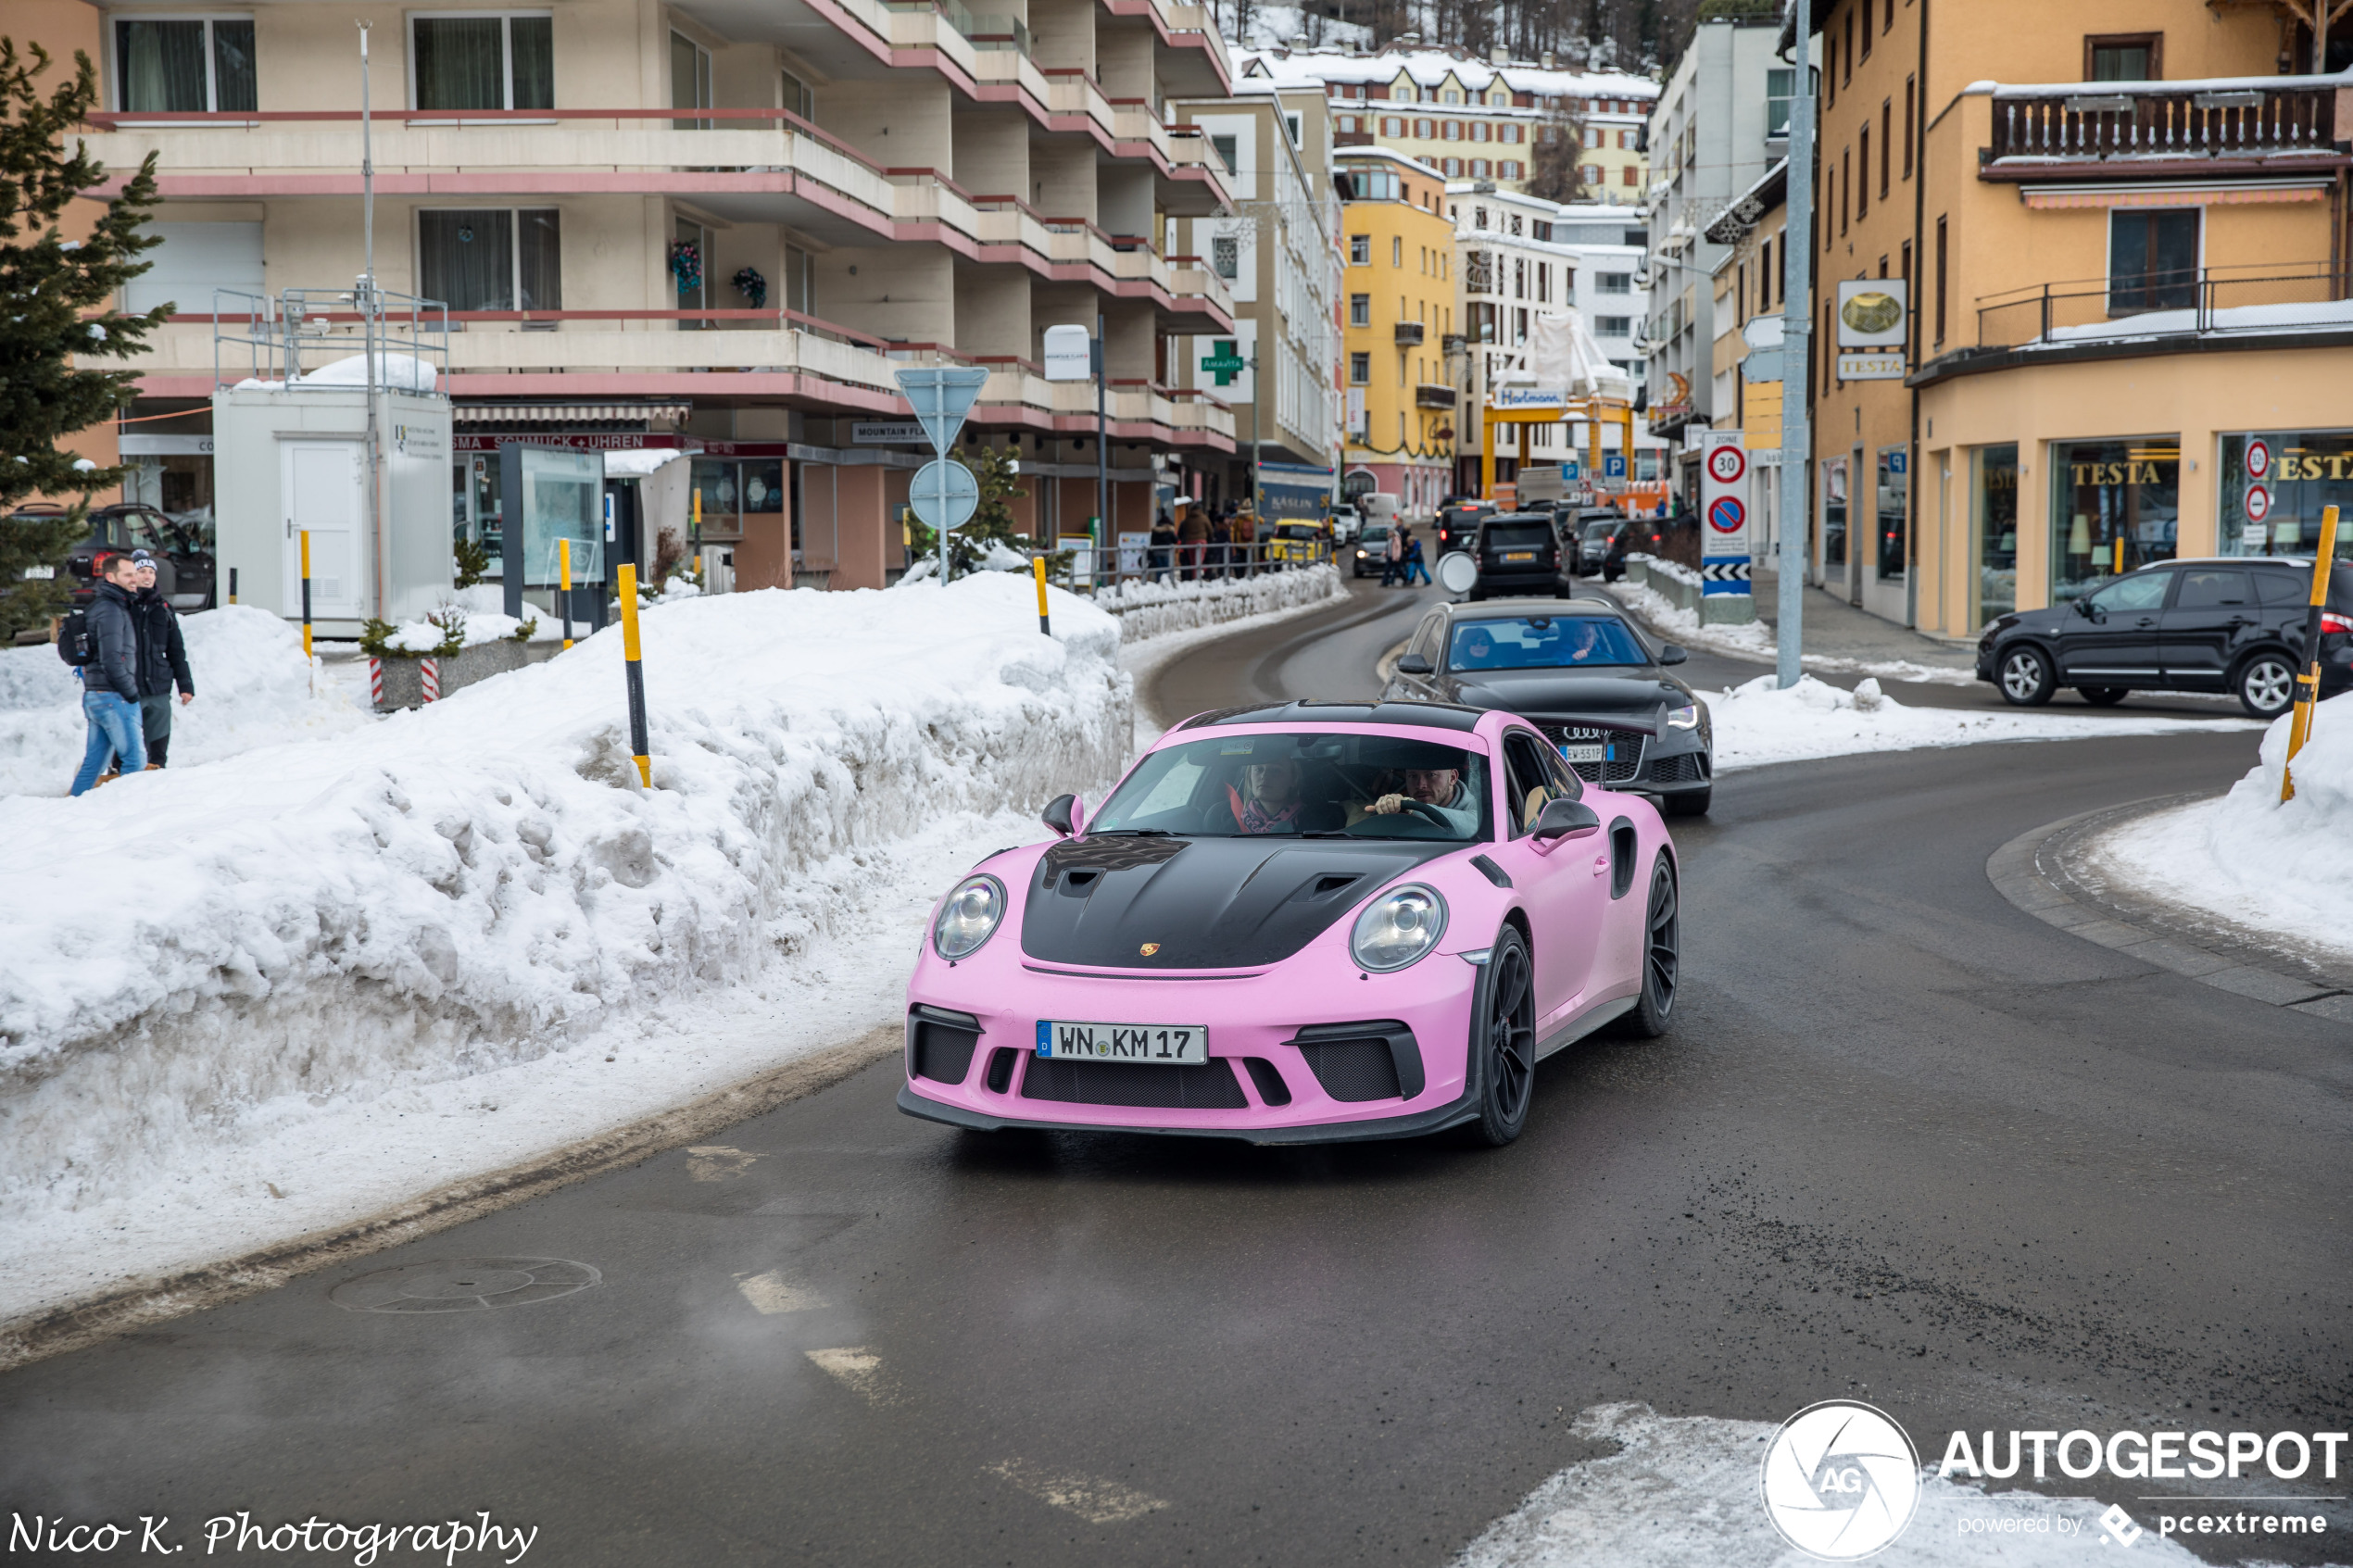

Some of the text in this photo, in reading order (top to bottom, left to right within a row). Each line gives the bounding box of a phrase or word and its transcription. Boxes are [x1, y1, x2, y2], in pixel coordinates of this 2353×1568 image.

[1842, 359, 1902, 373] TESTA
[858, 426, 927, 436] MOUNTAIN FLA
[588, 435, 644, 448] UHREN
[1716, 435, 1738, 444] ZONE
[1610, 458, 1622, 475] P
[1718, 457, 1736, 472] 30
[1567, 466, 1575, 478] P
[2070, 461, 2161, 486] TESTA
[1041, 1042, 1048, 1051] D
[1059, 1026, 1191, 1059] WN KM 17
